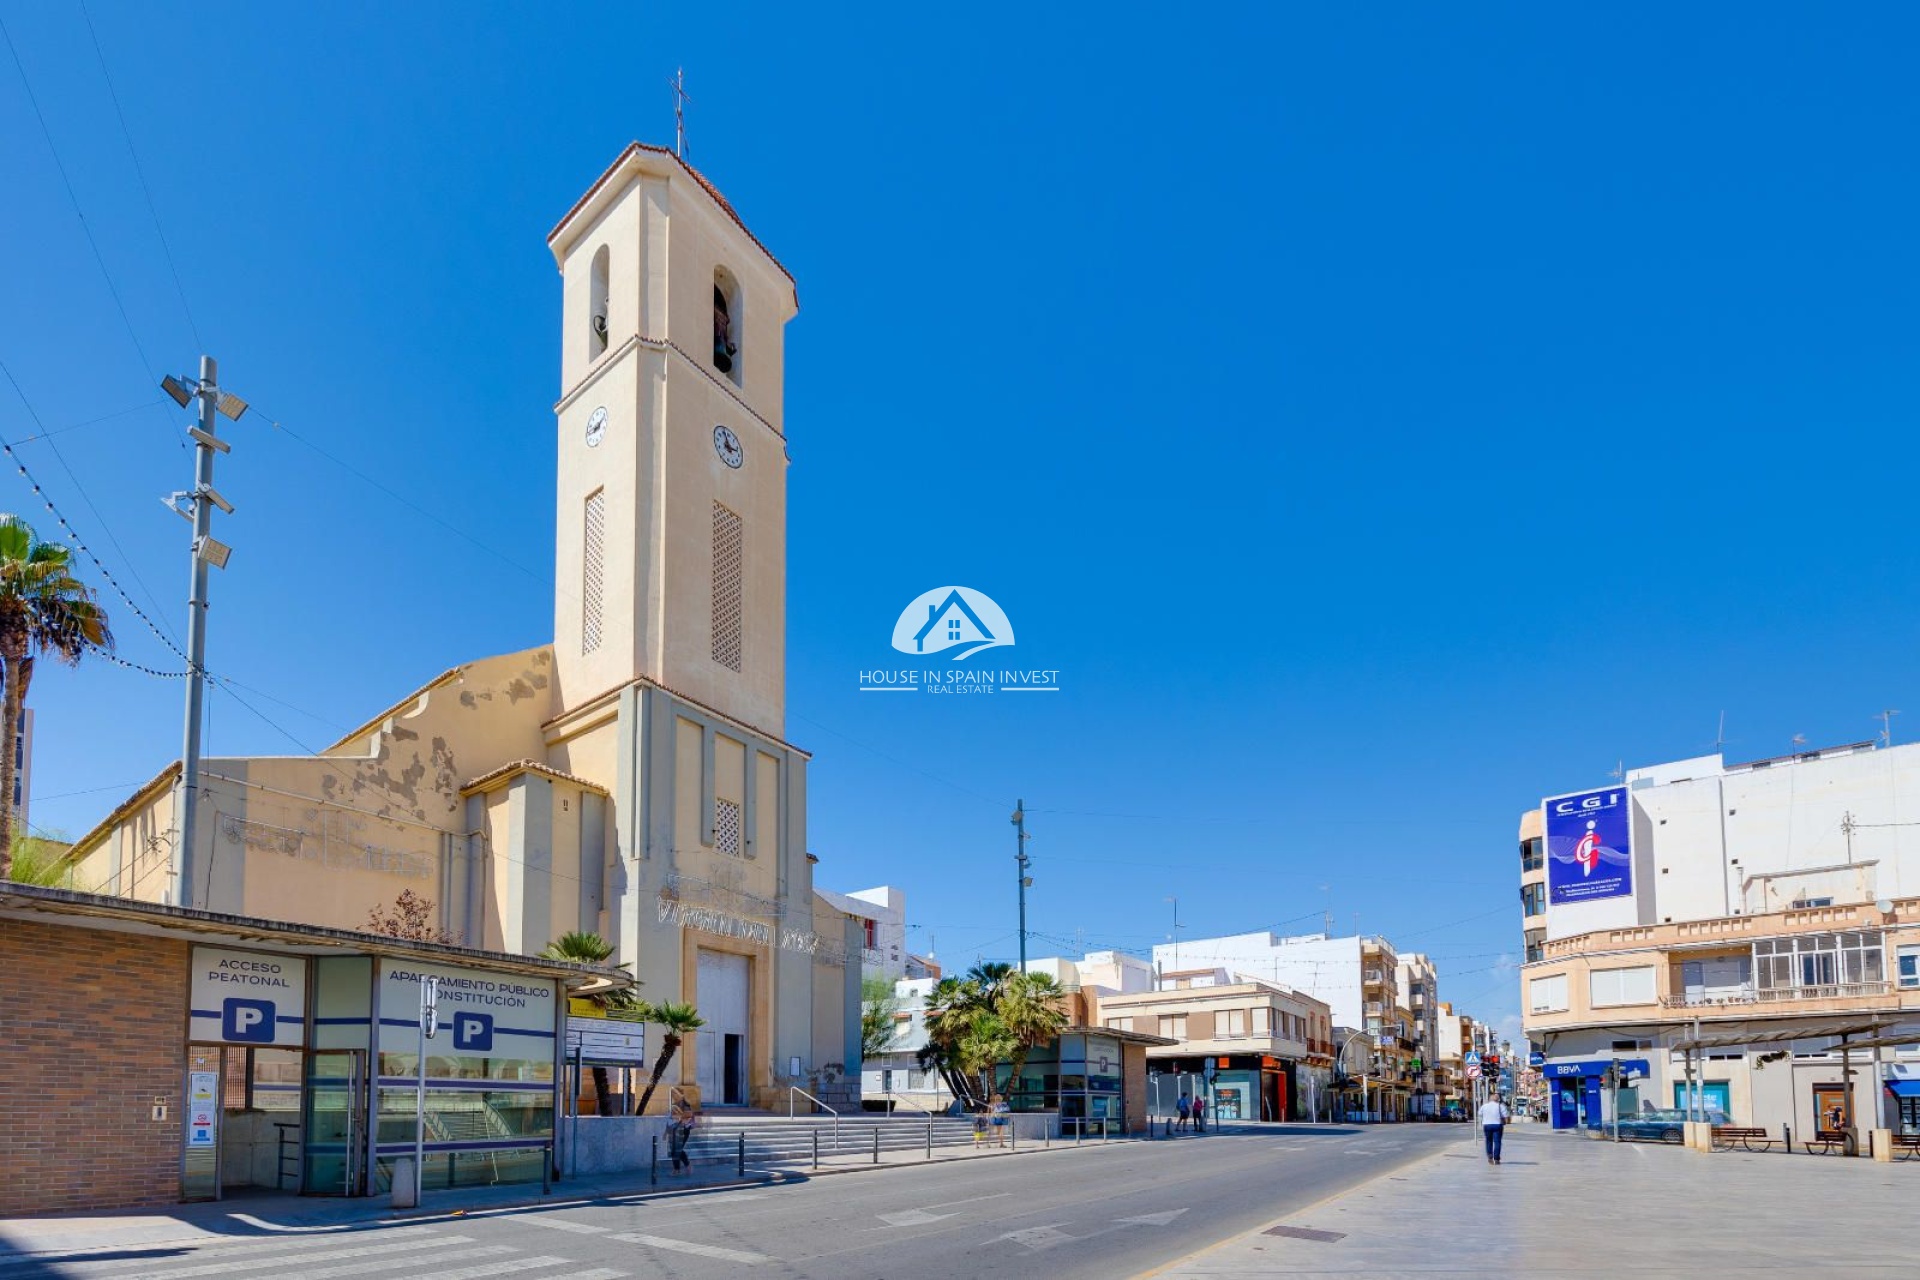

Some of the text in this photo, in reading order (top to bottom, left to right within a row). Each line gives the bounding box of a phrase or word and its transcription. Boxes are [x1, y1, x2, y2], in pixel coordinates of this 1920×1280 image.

[1556, 793, 1618, 813] CGI
[219, 959, 282, 974] ACCESO
[208, 971, 290, 988] PEATONAL
[437, 988, 526, 1009] ONSTITUCIÓN
[499, 982, 550, 999] PÚBLICO
[235, 1007, 264, 1034] P
[462, 1020, 484, 1044] P
[1556, 1064, 1581, 1075] BBVA
